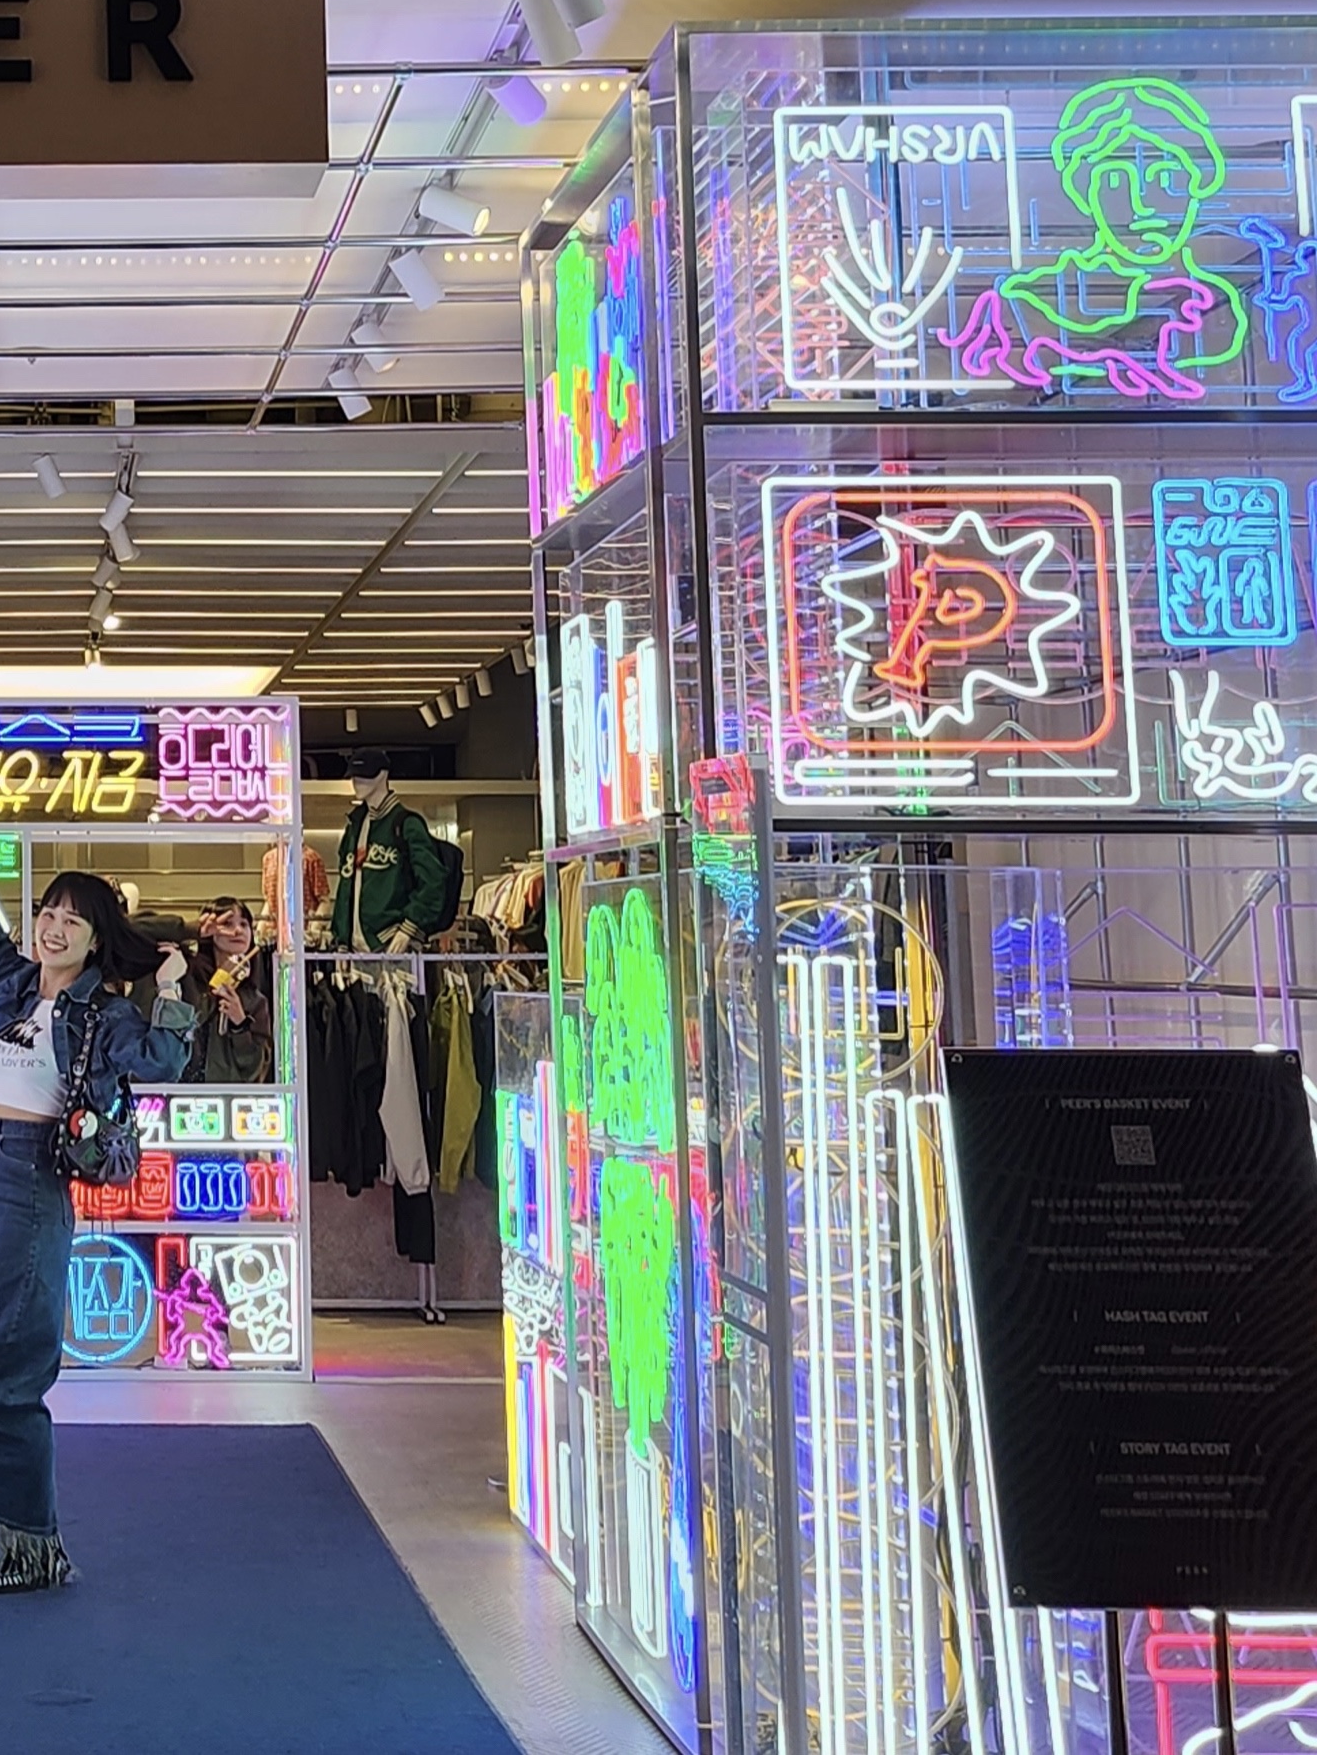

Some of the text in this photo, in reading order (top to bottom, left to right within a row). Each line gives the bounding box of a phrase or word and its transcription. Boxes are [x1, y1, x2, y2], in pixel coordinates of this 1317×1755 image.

[1103, 1097, 1150, 1110] BASKET
[1151, 1097, 1191, 1110] EVENT
[1104, 1309, 1209, 1324] HASH TAG EVENT
[1120, 1442, 1232, 1457] STORY TAG EVENT
